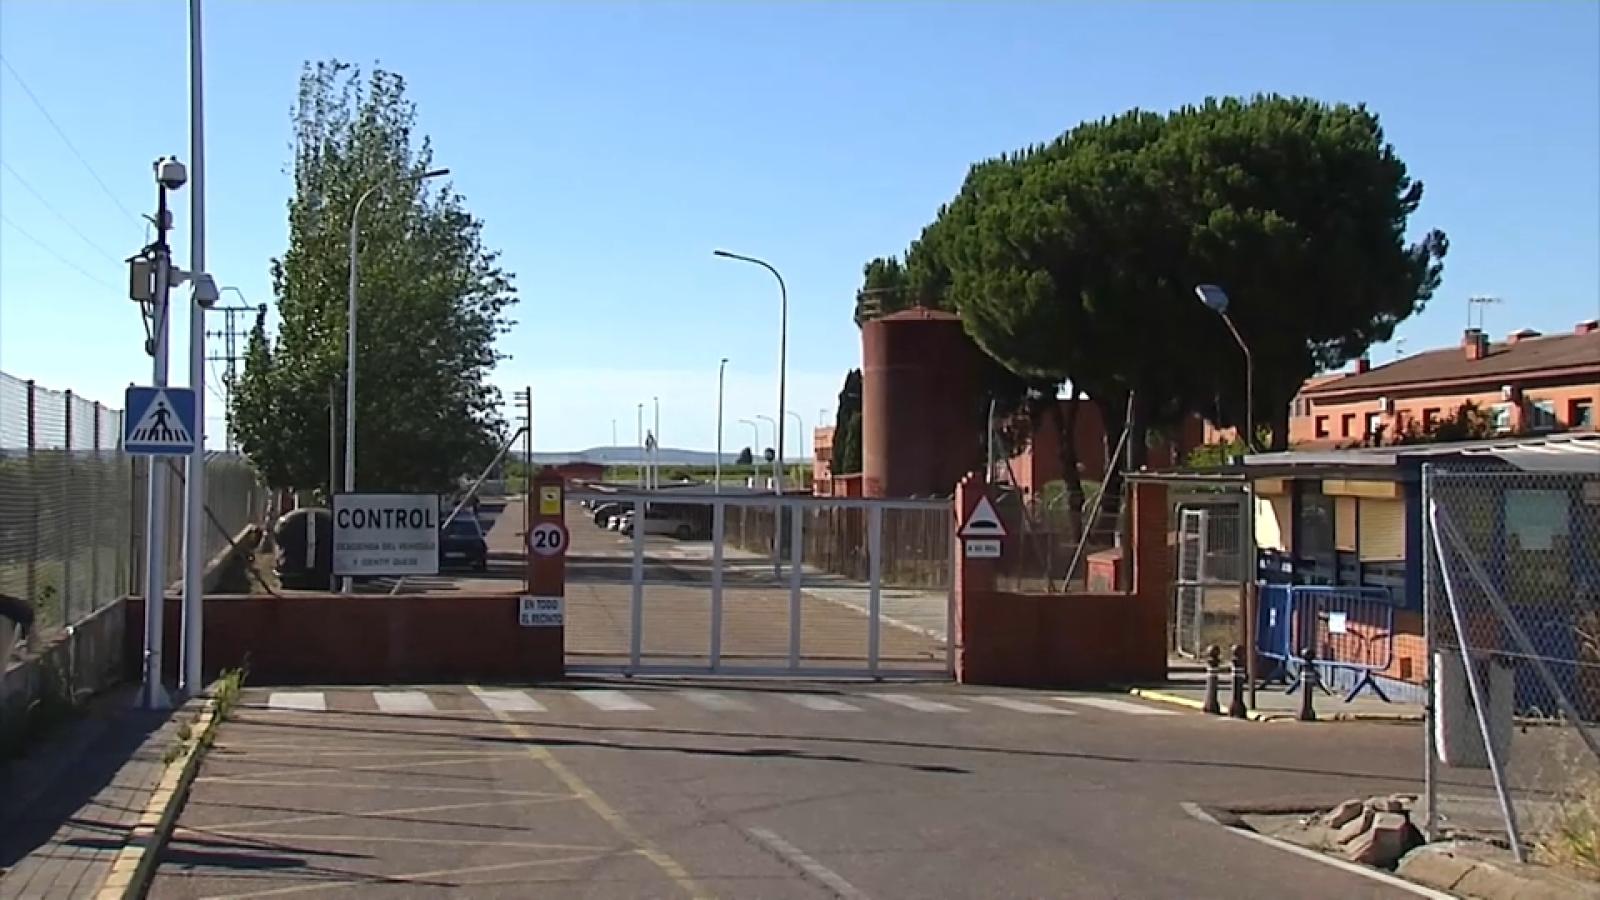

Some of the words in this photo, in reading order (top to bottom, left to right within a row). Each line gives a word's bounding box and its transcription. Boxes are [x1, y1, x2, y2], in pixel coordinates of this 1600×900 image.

[337, 508, 435, 529] CONTROL
[535, 530, 560, 548] 20
[524, 599, 534, 609] EN
[537, 599, 557, 609] TODO
